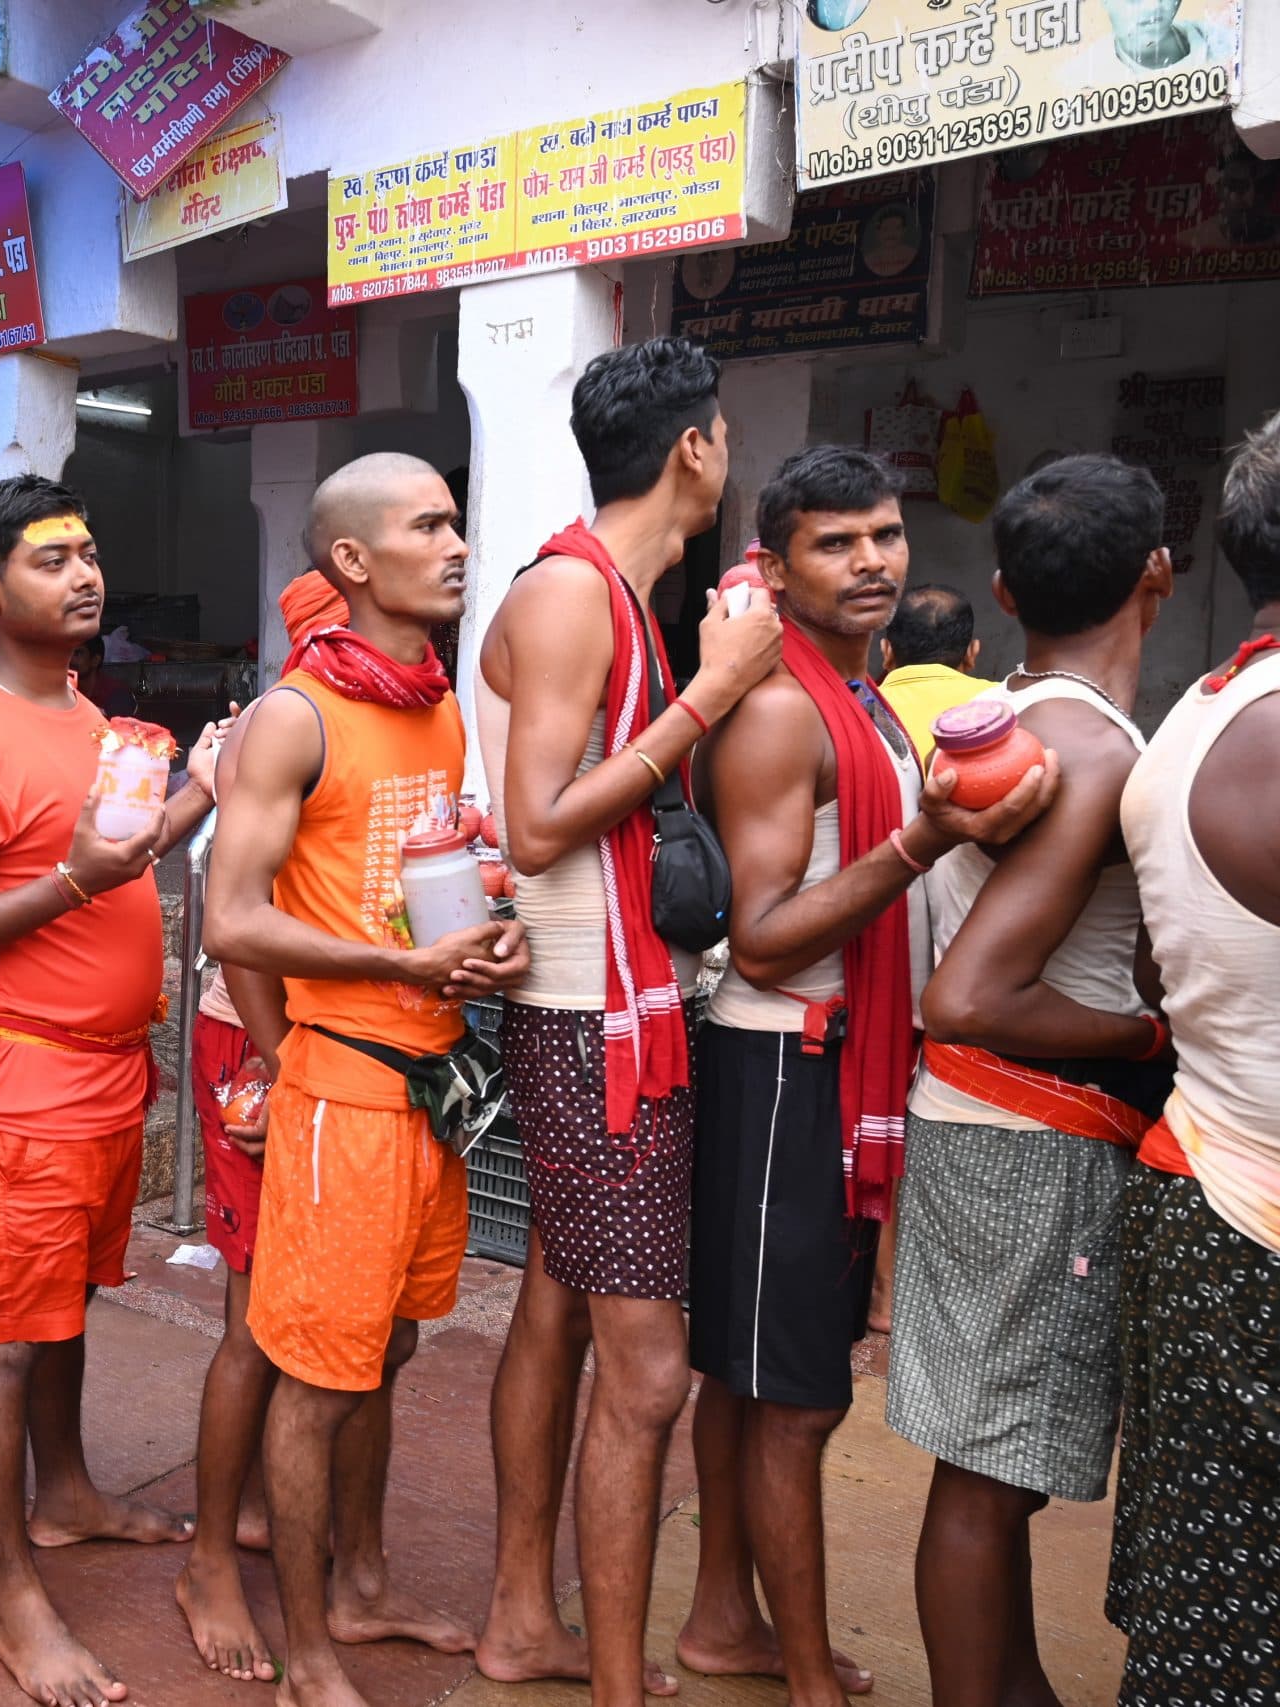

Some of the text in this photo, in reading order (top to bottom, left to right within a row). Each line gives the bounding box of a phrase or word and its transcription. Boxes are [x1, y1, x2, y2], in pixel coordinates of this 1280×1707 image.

[808, 32, 903, 105] प्रदीप
[938, 65, 1020, 107] पंडा)
[131, 158, 157, 179] पंडा
[201, 81, 230, 110] सभा
[677, 98, 719, 122] पण्डा
[809, 146, 871, 180] Mob.:
[877, 107, 1030, 165] 9031125695
[1036, 101, 1047, 133] /
[1052, 67, 1226, 129] 9110950300
[589, 154, 608, 185] जी
[699, 131, 736, 164] पंडा)
[477, 179, 506, 212] पंडा
[3, 229, 29, 273] पंडा
[587, 218, 725, 259] 9031529606
[485, 317, 534, 345] राम
[298, 371, 327, 395] पंडा
